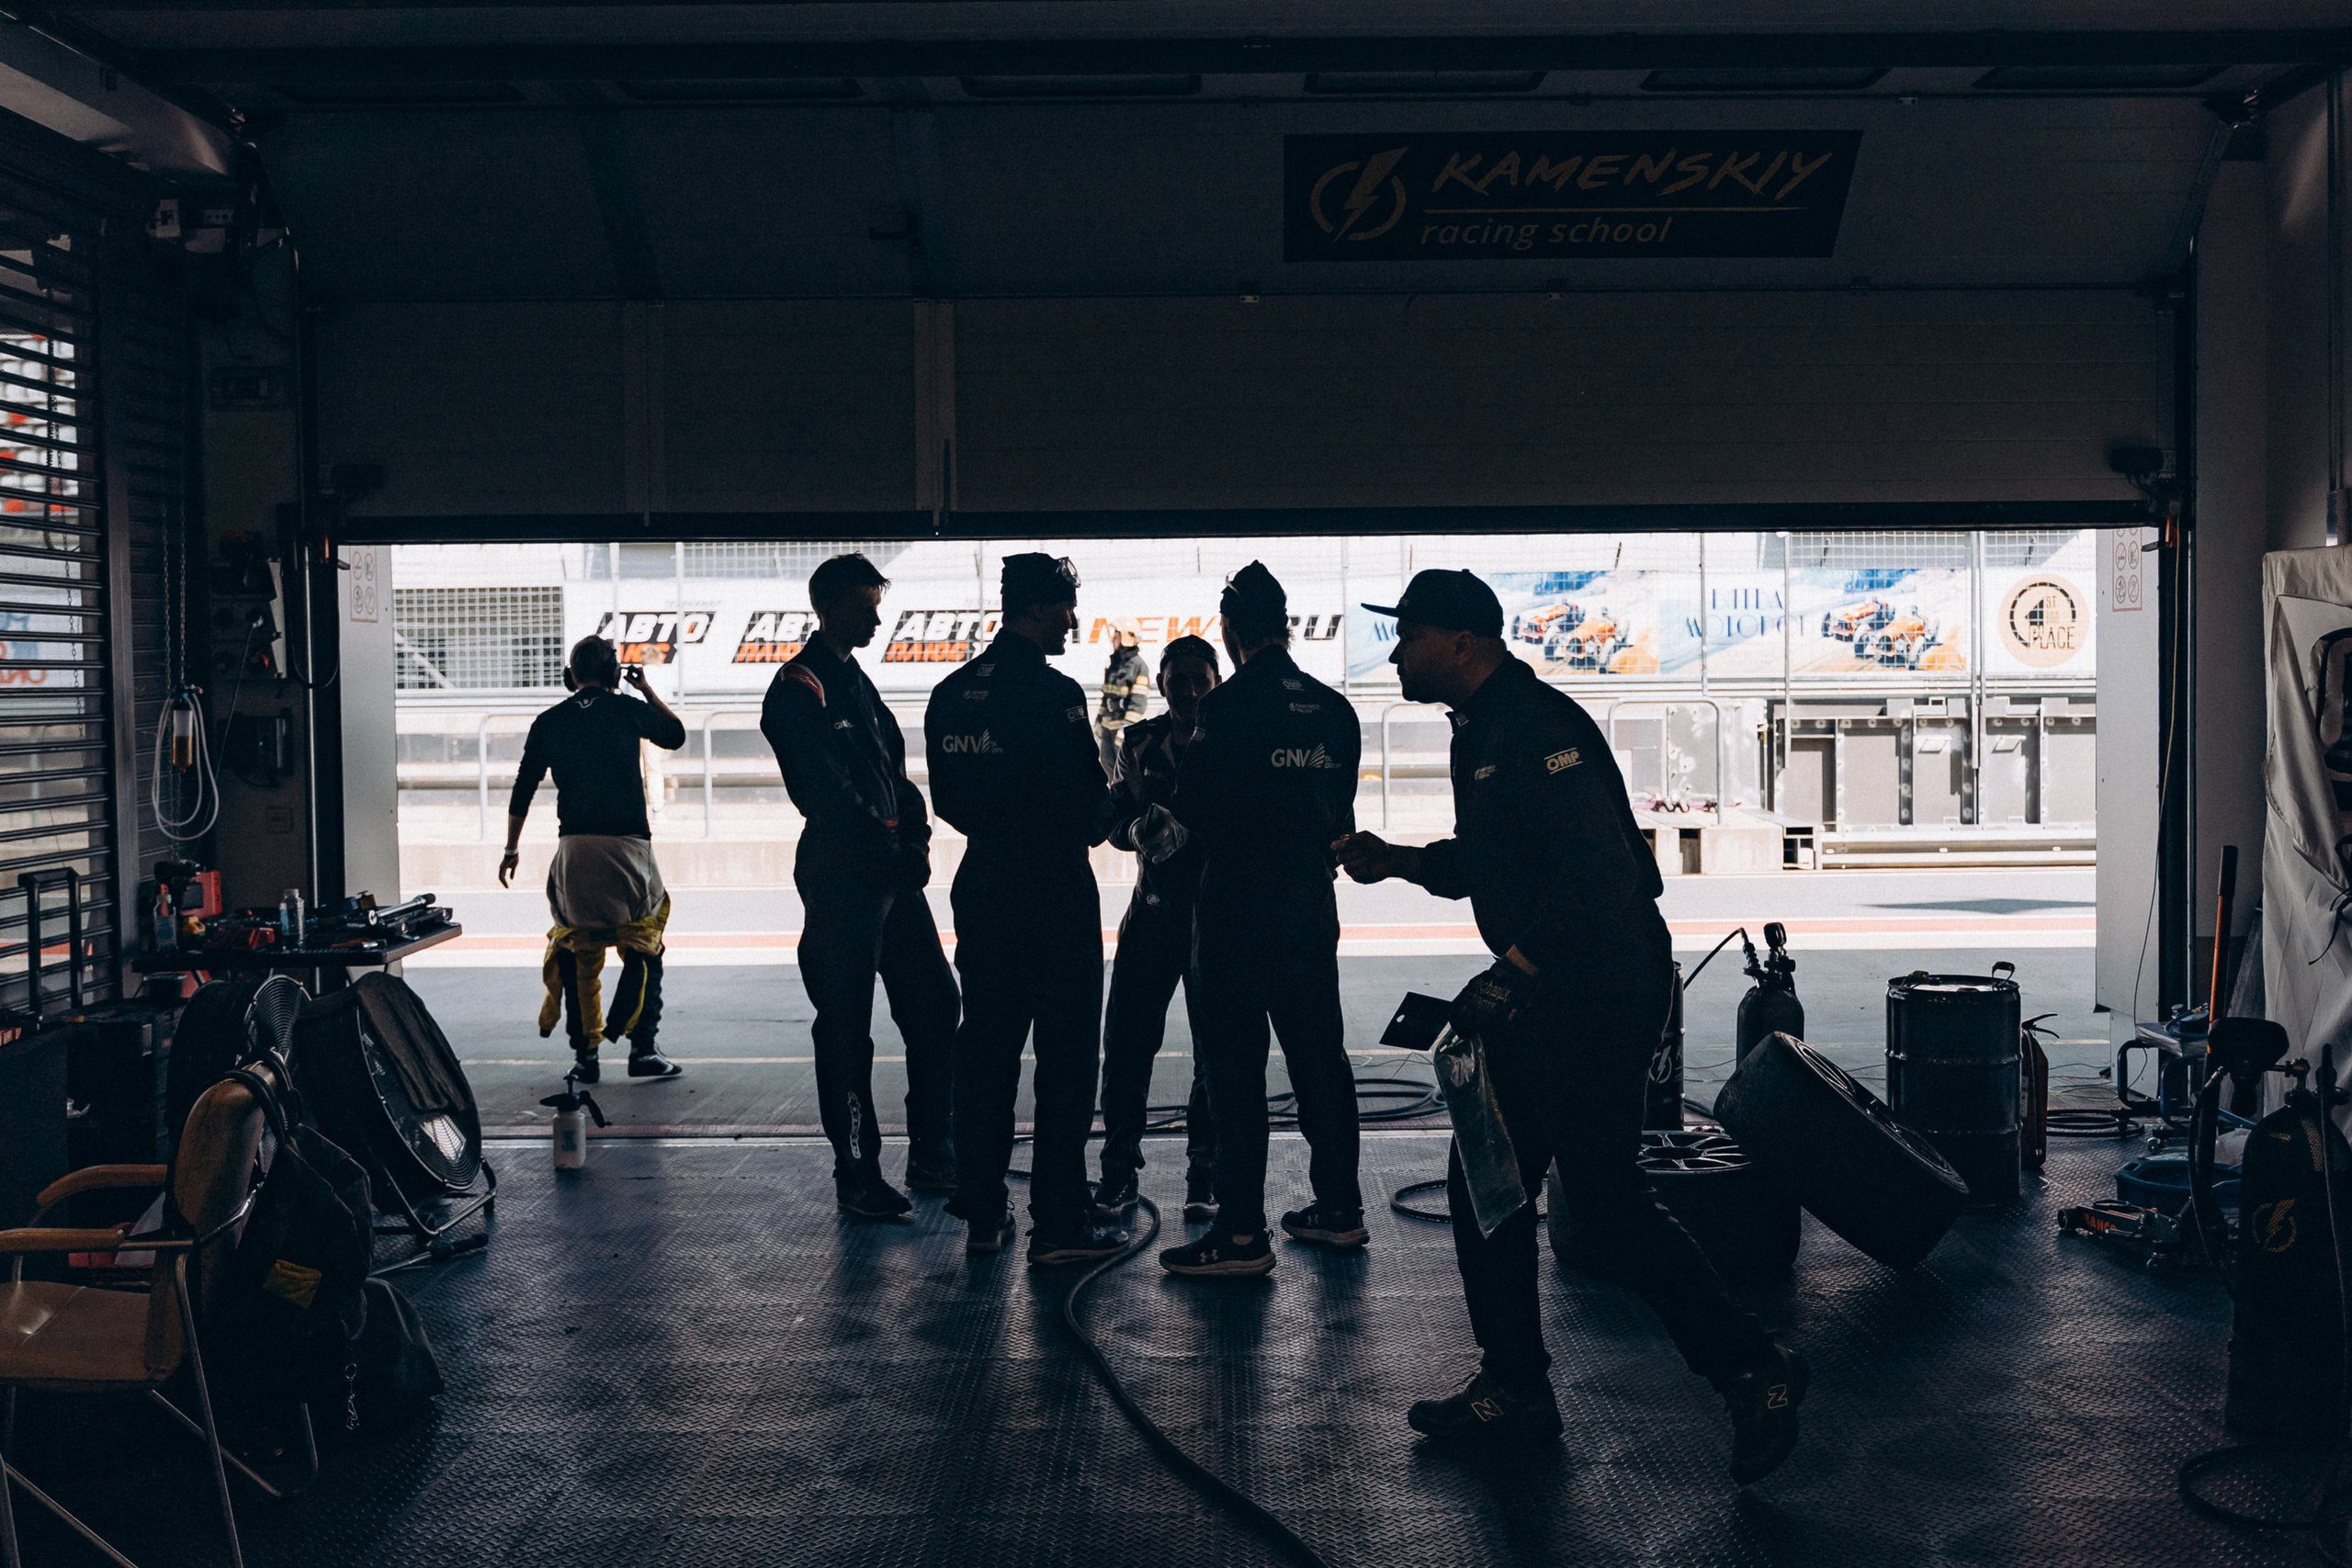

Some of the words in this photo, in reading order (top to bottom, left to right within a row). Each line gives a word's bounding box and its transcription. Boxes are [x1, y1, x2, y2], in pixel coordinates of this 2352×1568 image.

[1430, 146, 1833, 202] KAMENSKIY
[1419, 219, 1540, 251] racing
[1547, 217, 1673, 244] school
[942, 734, 982, 754] GNV
[1271, 748, 1312, 769] GNV
[1546, 750, 1580, 772] OMP
